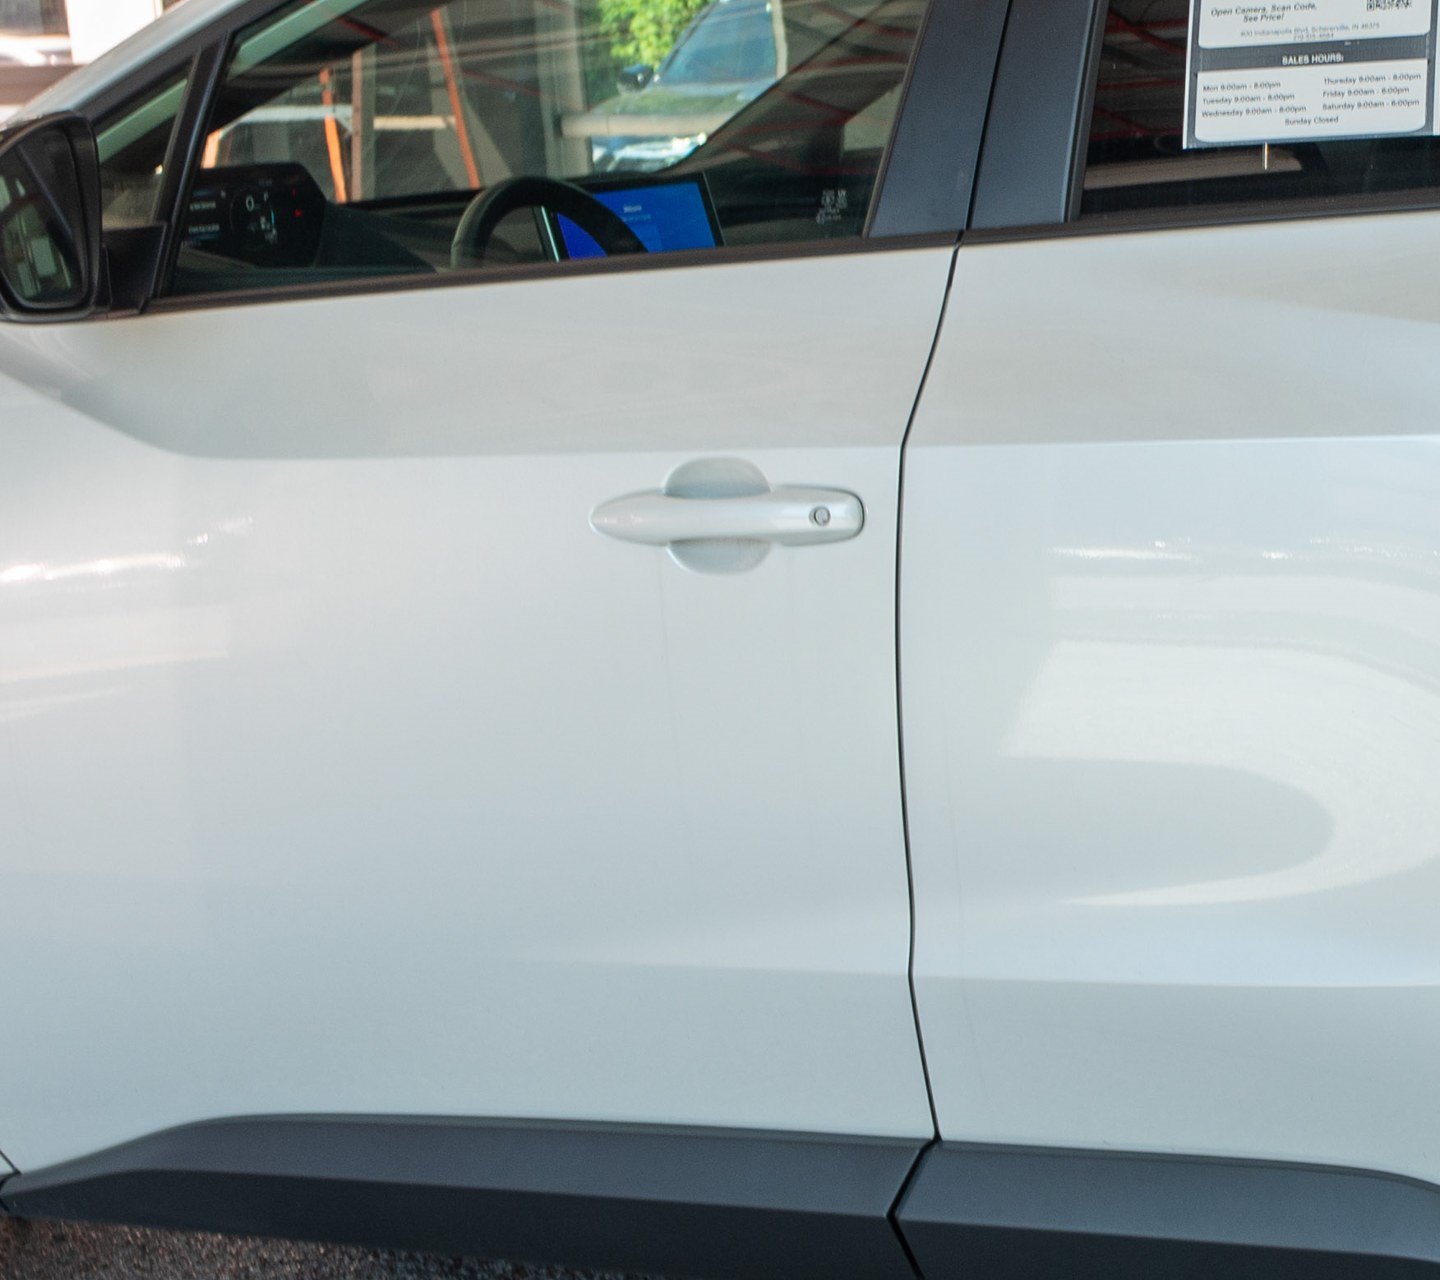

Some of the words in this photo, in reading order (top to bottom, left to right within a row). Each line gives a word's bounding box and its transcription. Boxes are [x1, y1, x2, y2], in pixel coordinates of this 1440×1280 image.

[1211, 6, 1233, 17] Open
[1271, 3, 1291, 12] Scan
[1243, 14, 1259, 23] See
[1261, 12, 1284, 21] Price!
[1282, 55, 1310, 65] SALES
[1311, 53, 1344, 64] HOURS:
[1324, 75, 1356, 85] Thursday
[1203, 84, 1218, 92] Mon
[1322, 89, 1345, 99] Friday
[1203, 96, 1232, 106] Tuesday
[1322, 102, 1355, 112] Saturday
[1201, 108, 1243, 118] Wednesday
[1285, 117, 1312, 126] Sunday
[1314, 115, 1339, 124] Closed
